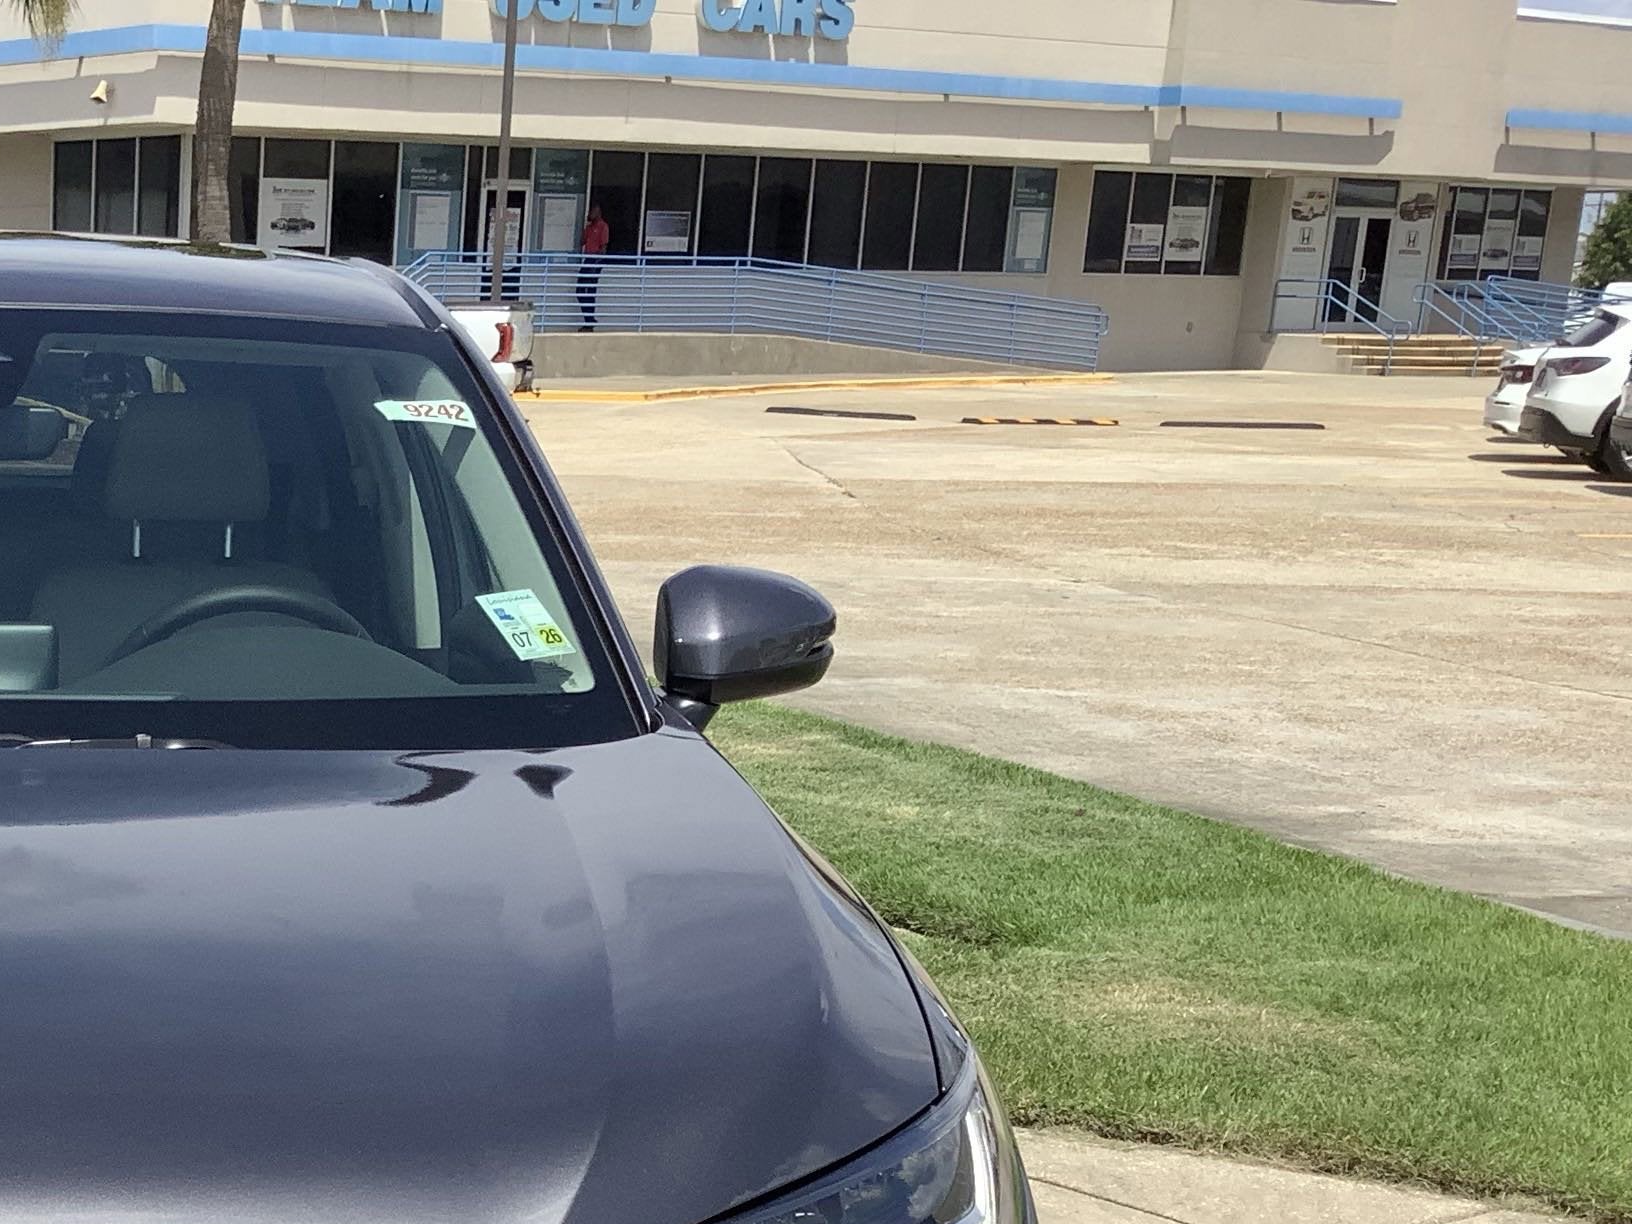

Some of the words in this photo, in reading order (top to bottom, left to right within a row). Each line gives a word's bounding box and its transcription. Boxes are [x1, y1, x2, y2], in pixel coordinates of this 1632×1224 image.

[698, 0, 856, 41] CARS
[402, 403, 469, 422] 9242
[511, 631, 533, 648] 07
[539, 628, 563, 644] 26
